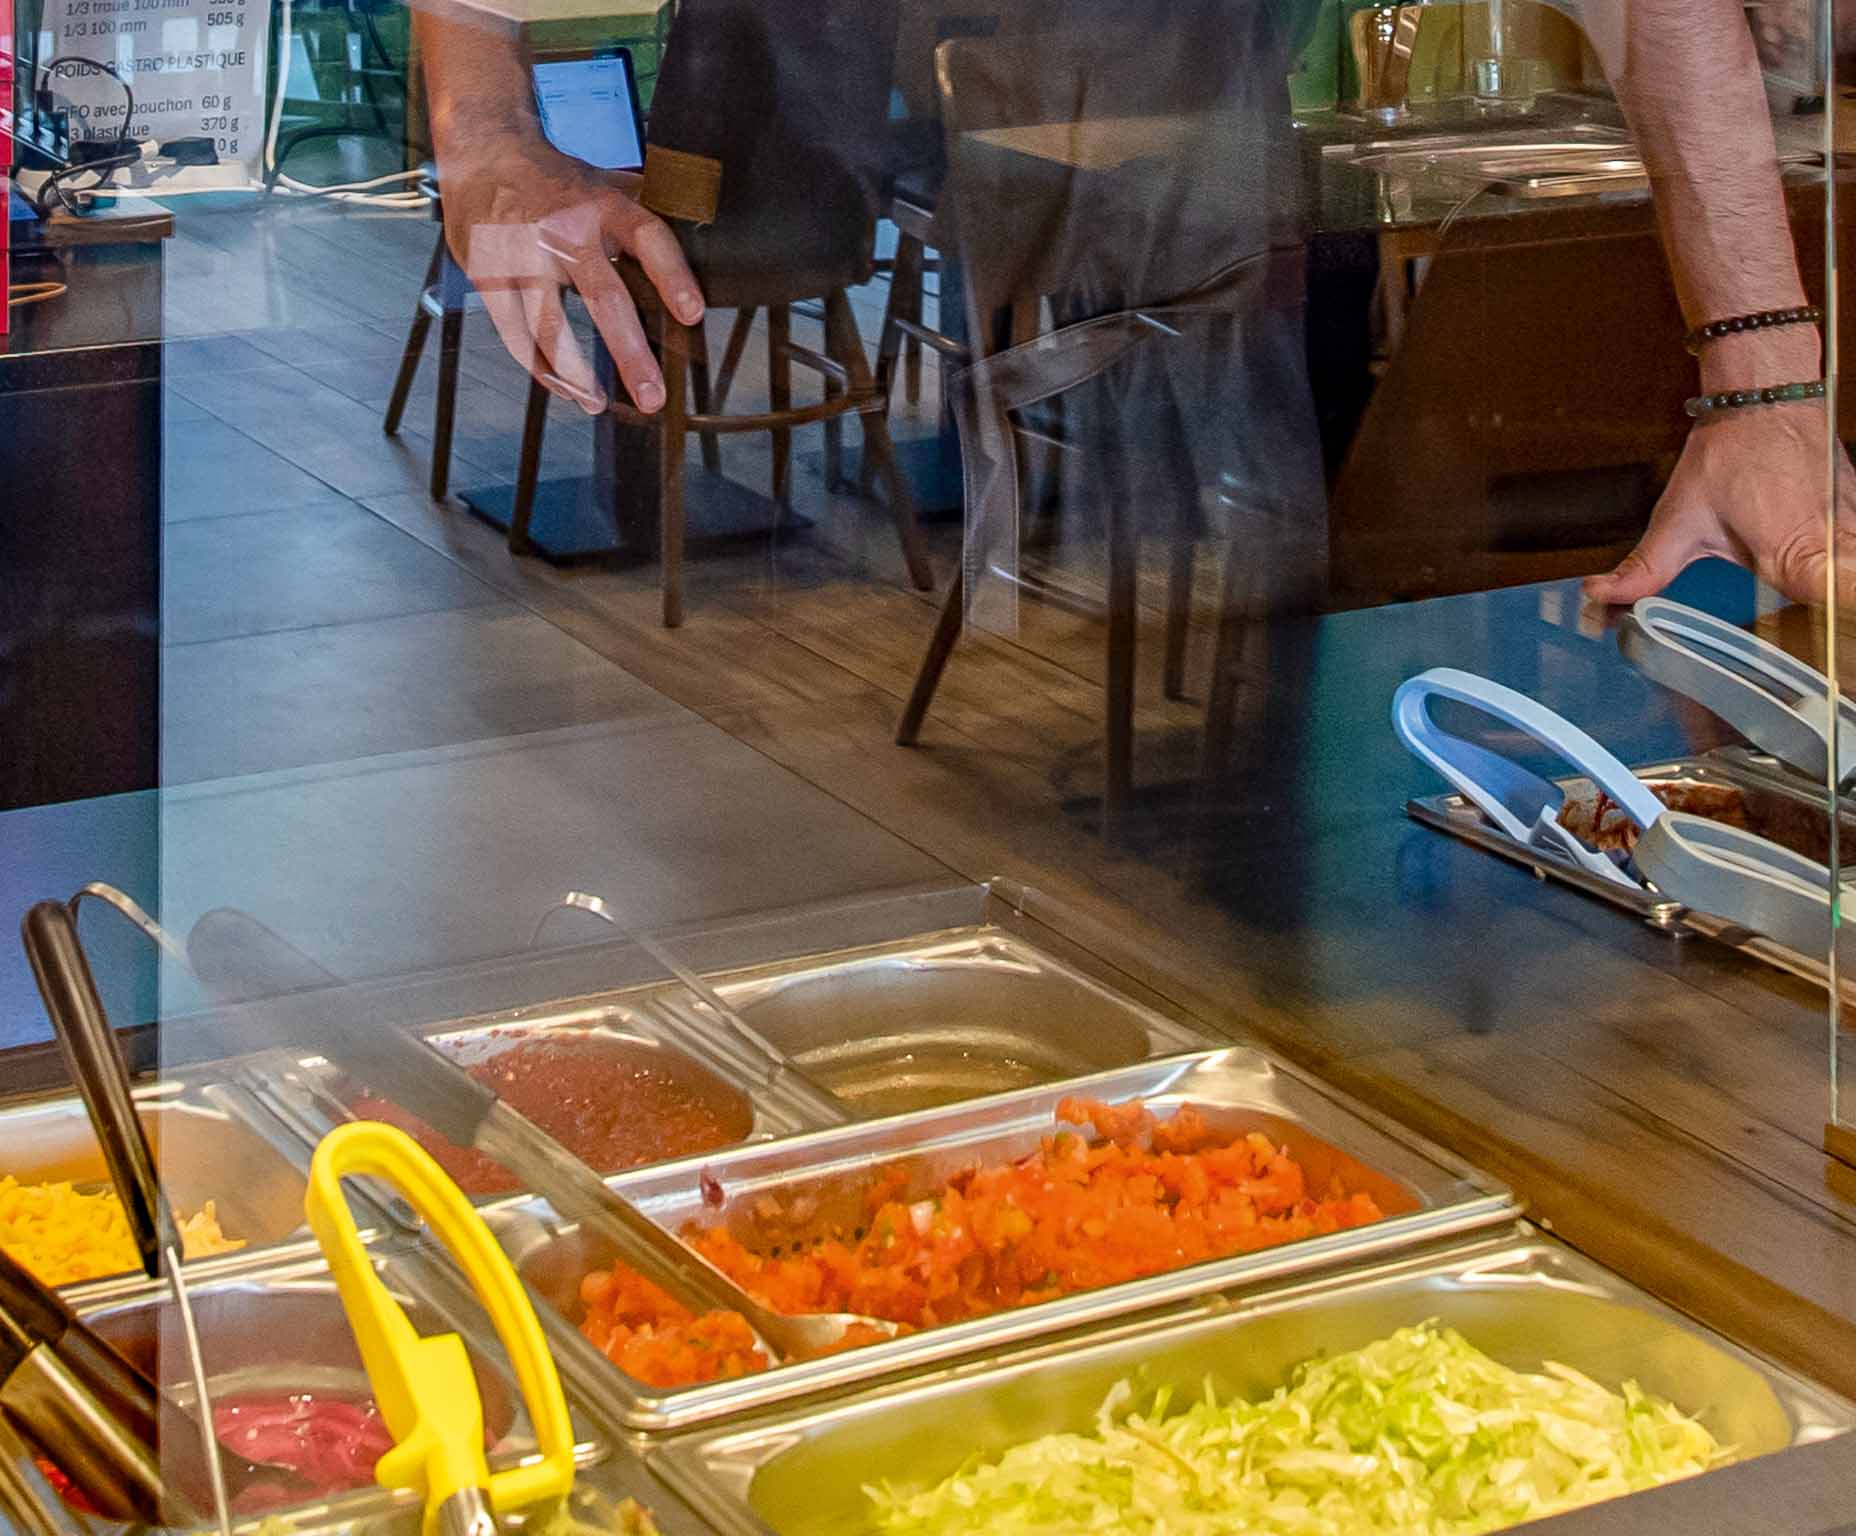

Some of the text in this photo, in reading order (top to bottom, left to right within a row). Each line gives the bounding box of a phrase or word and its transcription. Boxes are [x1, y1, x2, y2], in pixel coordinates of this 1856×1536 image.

[67, 1, 89, 15] 1/3
[64, 13, 244, 37] 1/3 100 mm 505 g
[55, 63, 100, 78] POIDS
[168, 51, 245, 70] PLASTIQUE
[94, 104, 126, 118] avec
[202, 96, 219, 109] 60
[224, 96, 232, 110] g
[201, 117, 239, 132] 370 g
